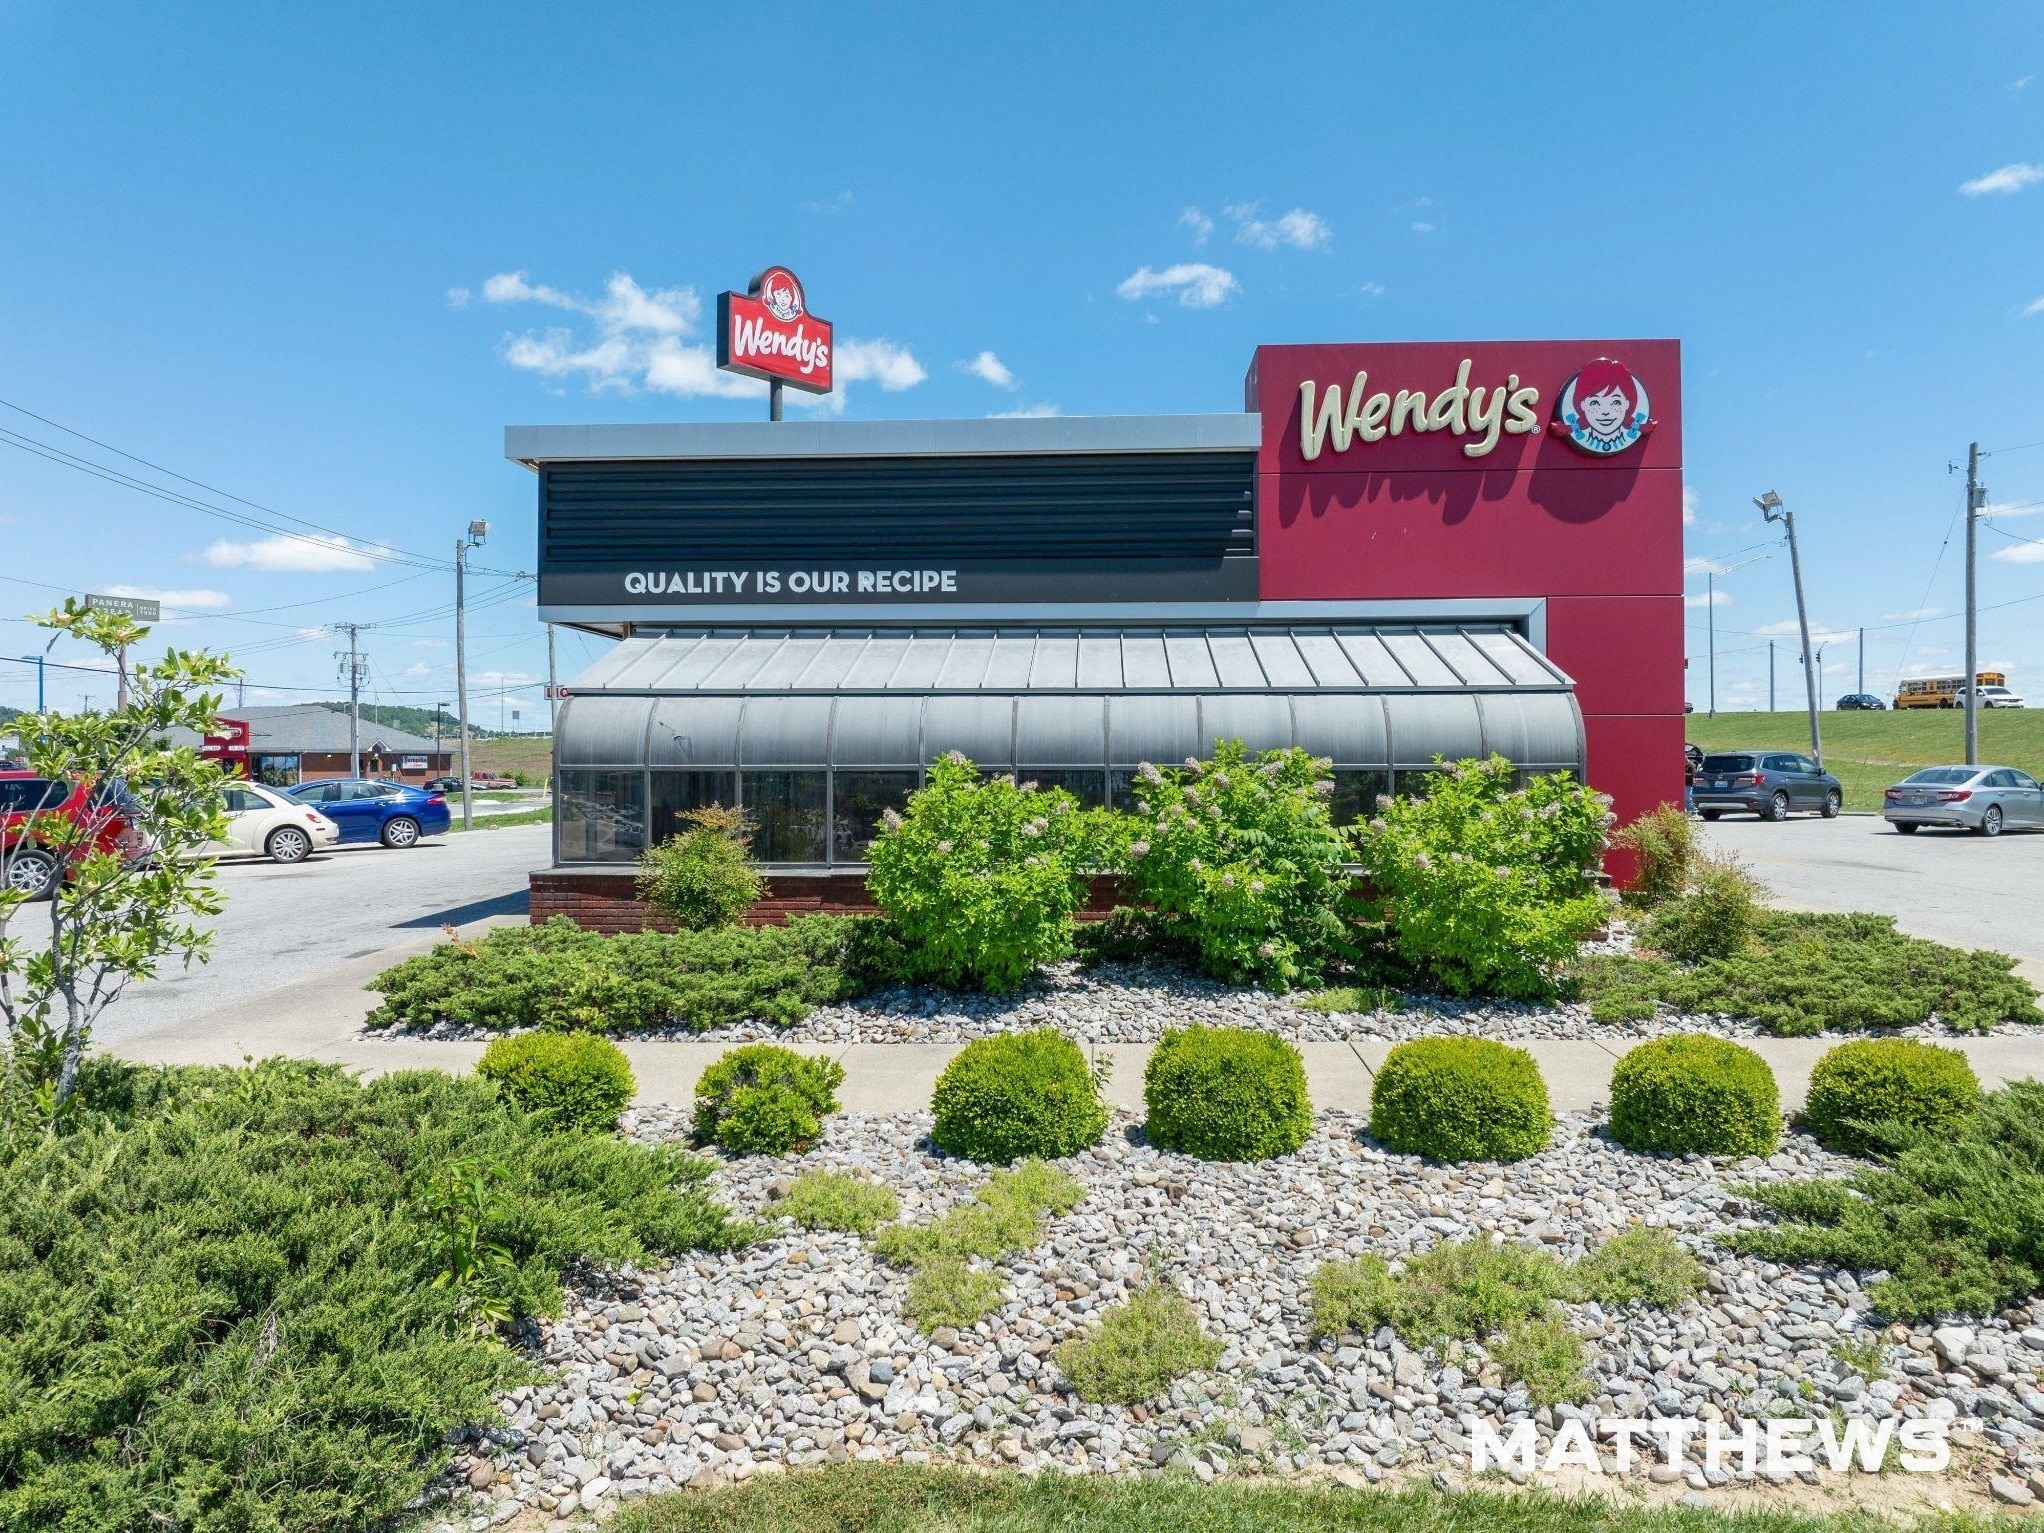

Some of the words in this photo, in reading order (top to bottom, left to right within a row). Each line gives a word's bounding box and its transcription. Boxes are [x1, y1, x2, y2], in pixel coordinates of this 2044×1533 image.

[735, 314, 829, 374] Wendy's
[1300, 359, 1540, 461] Wendy's
[624, 571, 748, 594] QUALITY
[757, 571, 781, 593] IS
[789, 571, 849, 593] OUR
[858, 570, 957, 592] RECIPE
[92, 598, 133, 609] PANERA
